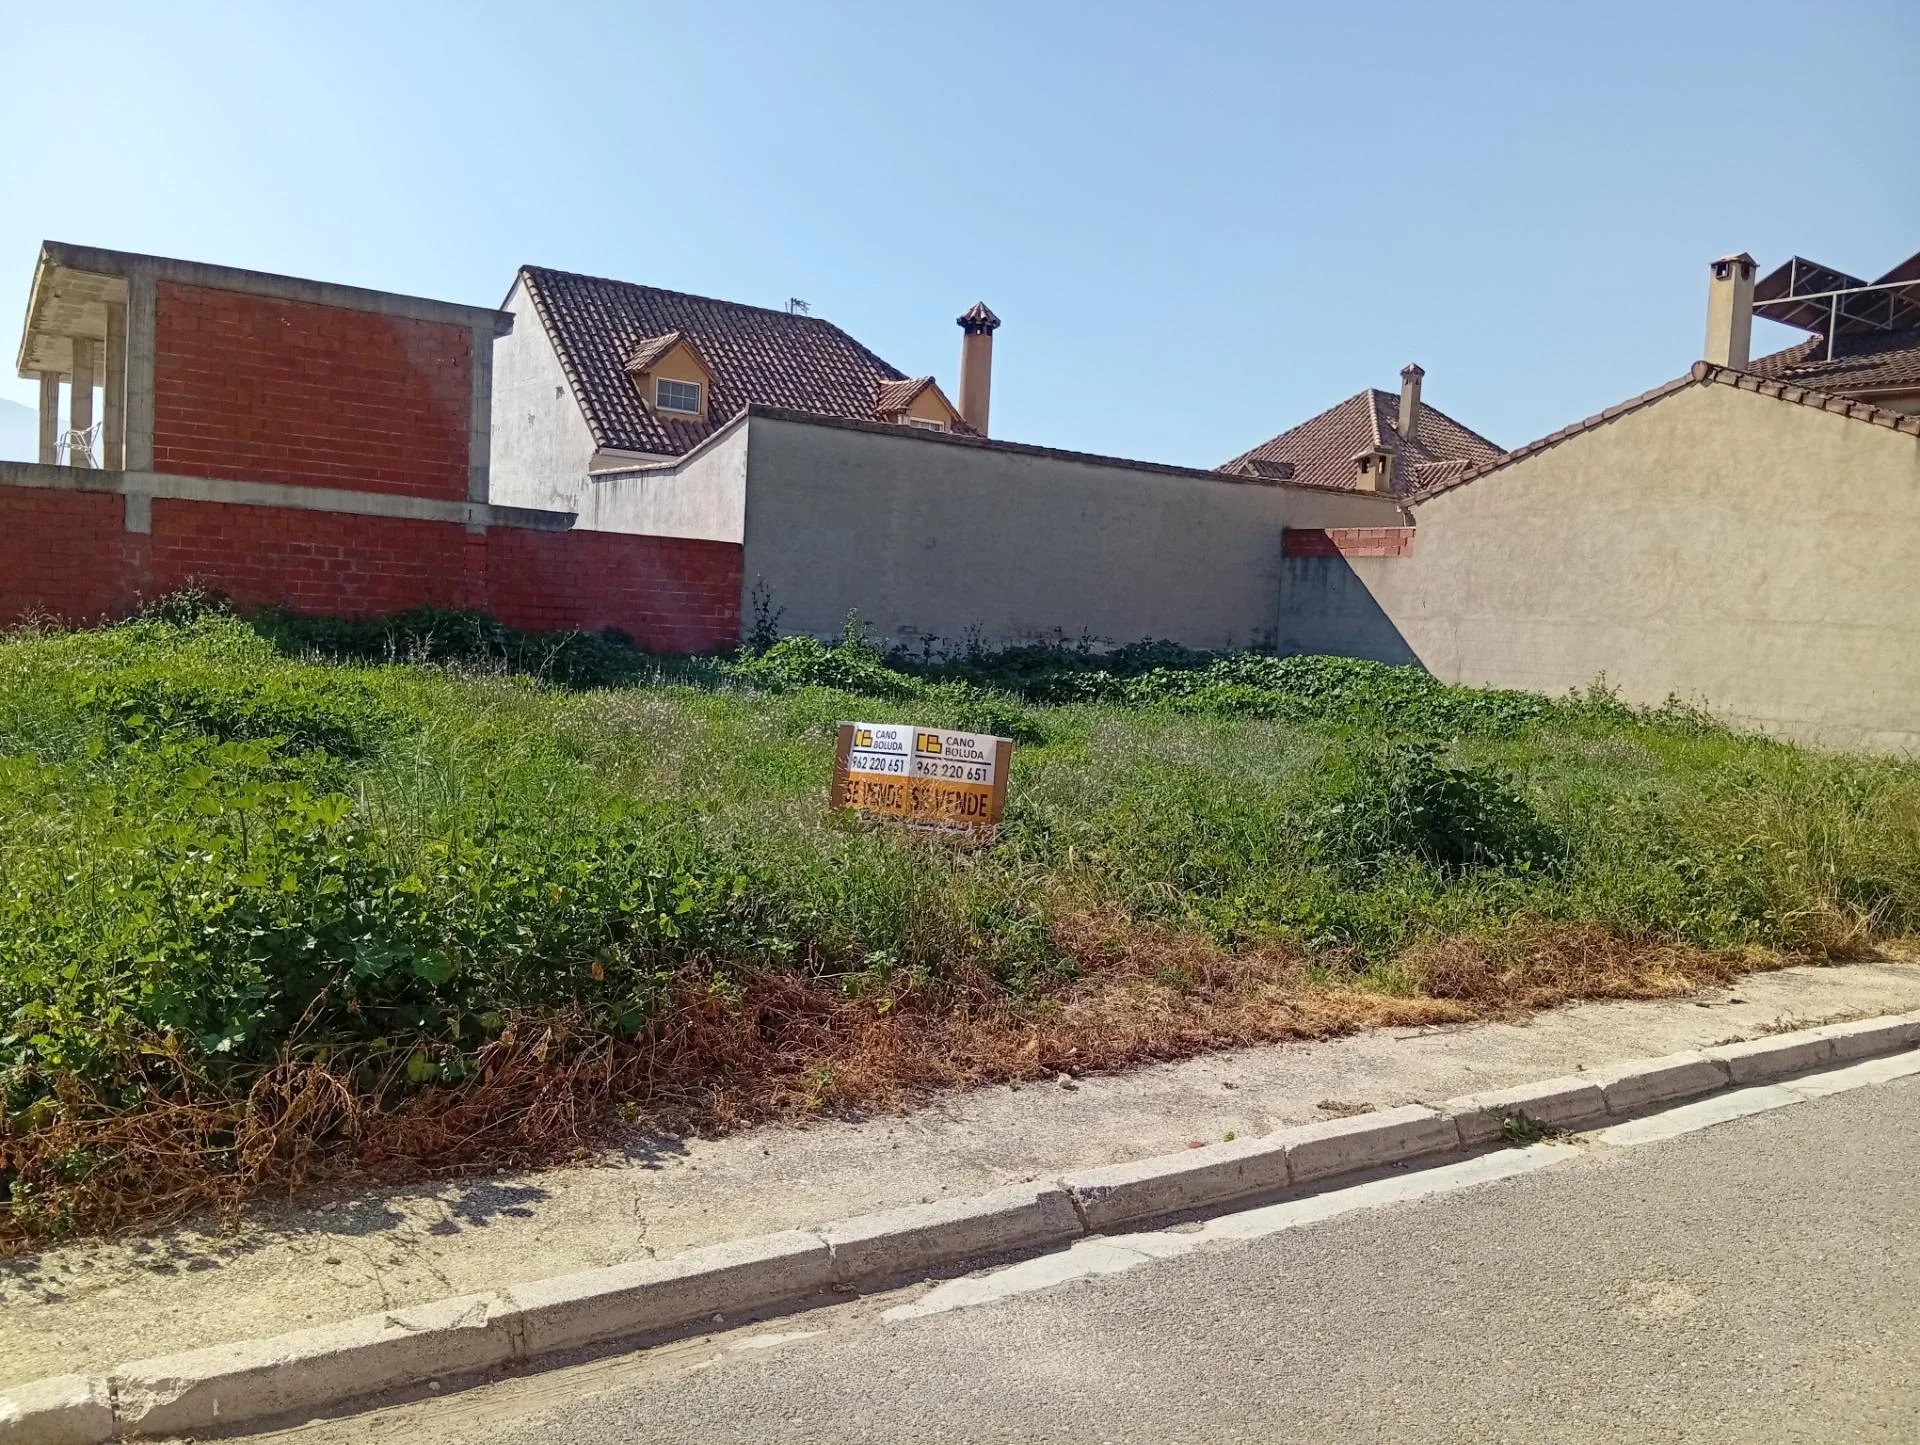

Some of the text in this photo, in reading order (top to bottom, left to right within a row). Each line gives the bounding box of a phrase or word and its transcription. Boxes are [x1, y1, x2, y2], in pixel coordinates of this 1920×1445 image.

[876, 730, 897, 740] CANO
[873, 740, 903, 751] BOLUDA
[946, 737, 975, 748] CANO
[945, 747, 984, 760] BOLUDA
[852, 756, 904, 772] 962 220 651
[942, 764, 964, 778] 220
[967, 768, 987, 781] 651
